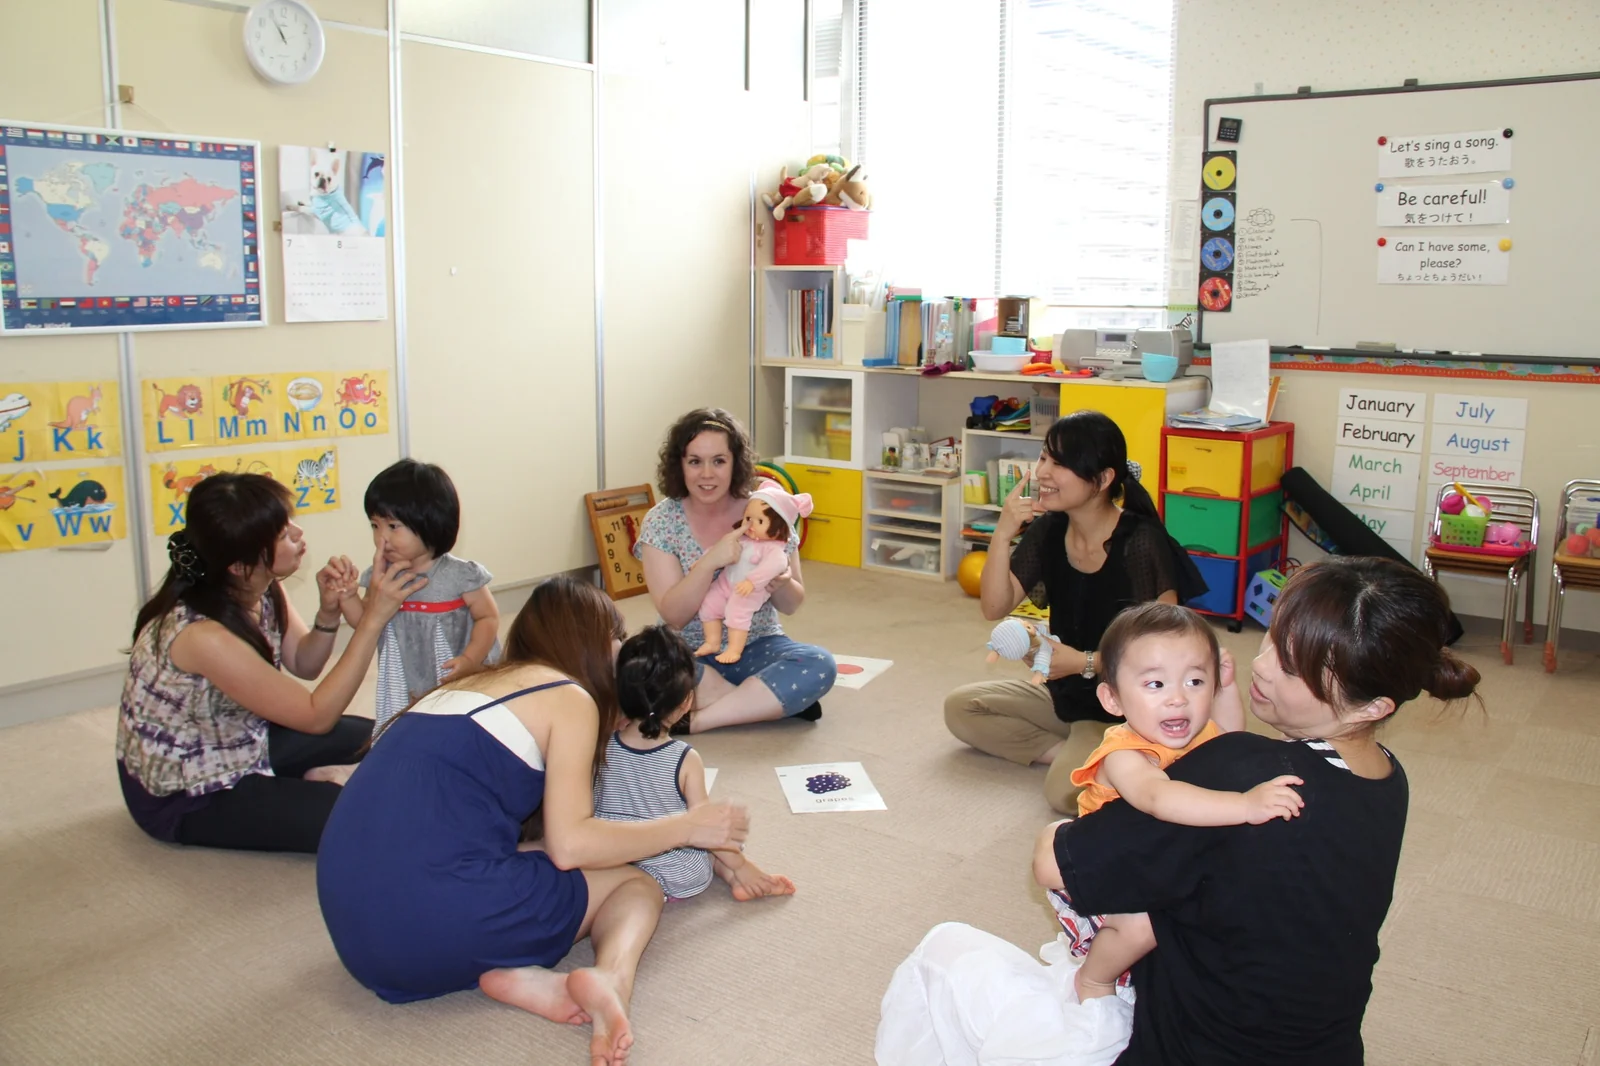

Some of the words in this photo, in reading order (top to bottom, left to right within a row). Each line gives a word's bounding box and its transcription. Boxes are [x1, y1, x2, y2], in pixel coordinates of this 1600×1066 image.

[1390, 140, 1420, 153] Let's
[1424, 139, 1450, 153] sing
[1454, 140, 1461, 149] a
[1465, 137, 1499, 149] song.
[1404, 155, 1476, 168] 歌をうたおう。
[1398, 191, 1417, 206] Be
[1423, 189, 1487, 206] careful!
[285, 239, 293, 248] 7
[337, 240, 343, 249] 8
[1395, 242, 1415, 252] Can
[1418, 242, 1425, 252] I
[1428, 241, 1454, 252] have
[1458, 242, 1490, 253] some,
[1420, 258, 1462, 271] please?
[1346, 394, 1415, 418] January
[1456, 401, 1495, 424] July
[1342, 422, 1416, 448] February
[13, 430, 25, 461] j
[1446, 432, 1510, 454] August
[1348, 454, 1402, 474] March
[1433, 462, 1515, 482] September
[1350, 483, 1391, 502] April
[169, 502, 186, 526] X
[611, 521, 620, 531] 11
[605, 533, 615, 544] 10
[607, 549, 615, 559] 9
[614, 562, 622, 573] 8
[625, 572, 631, 582] 7
[636, 573, 644, 584] 6
[815, 796, 855, 804] grapes
